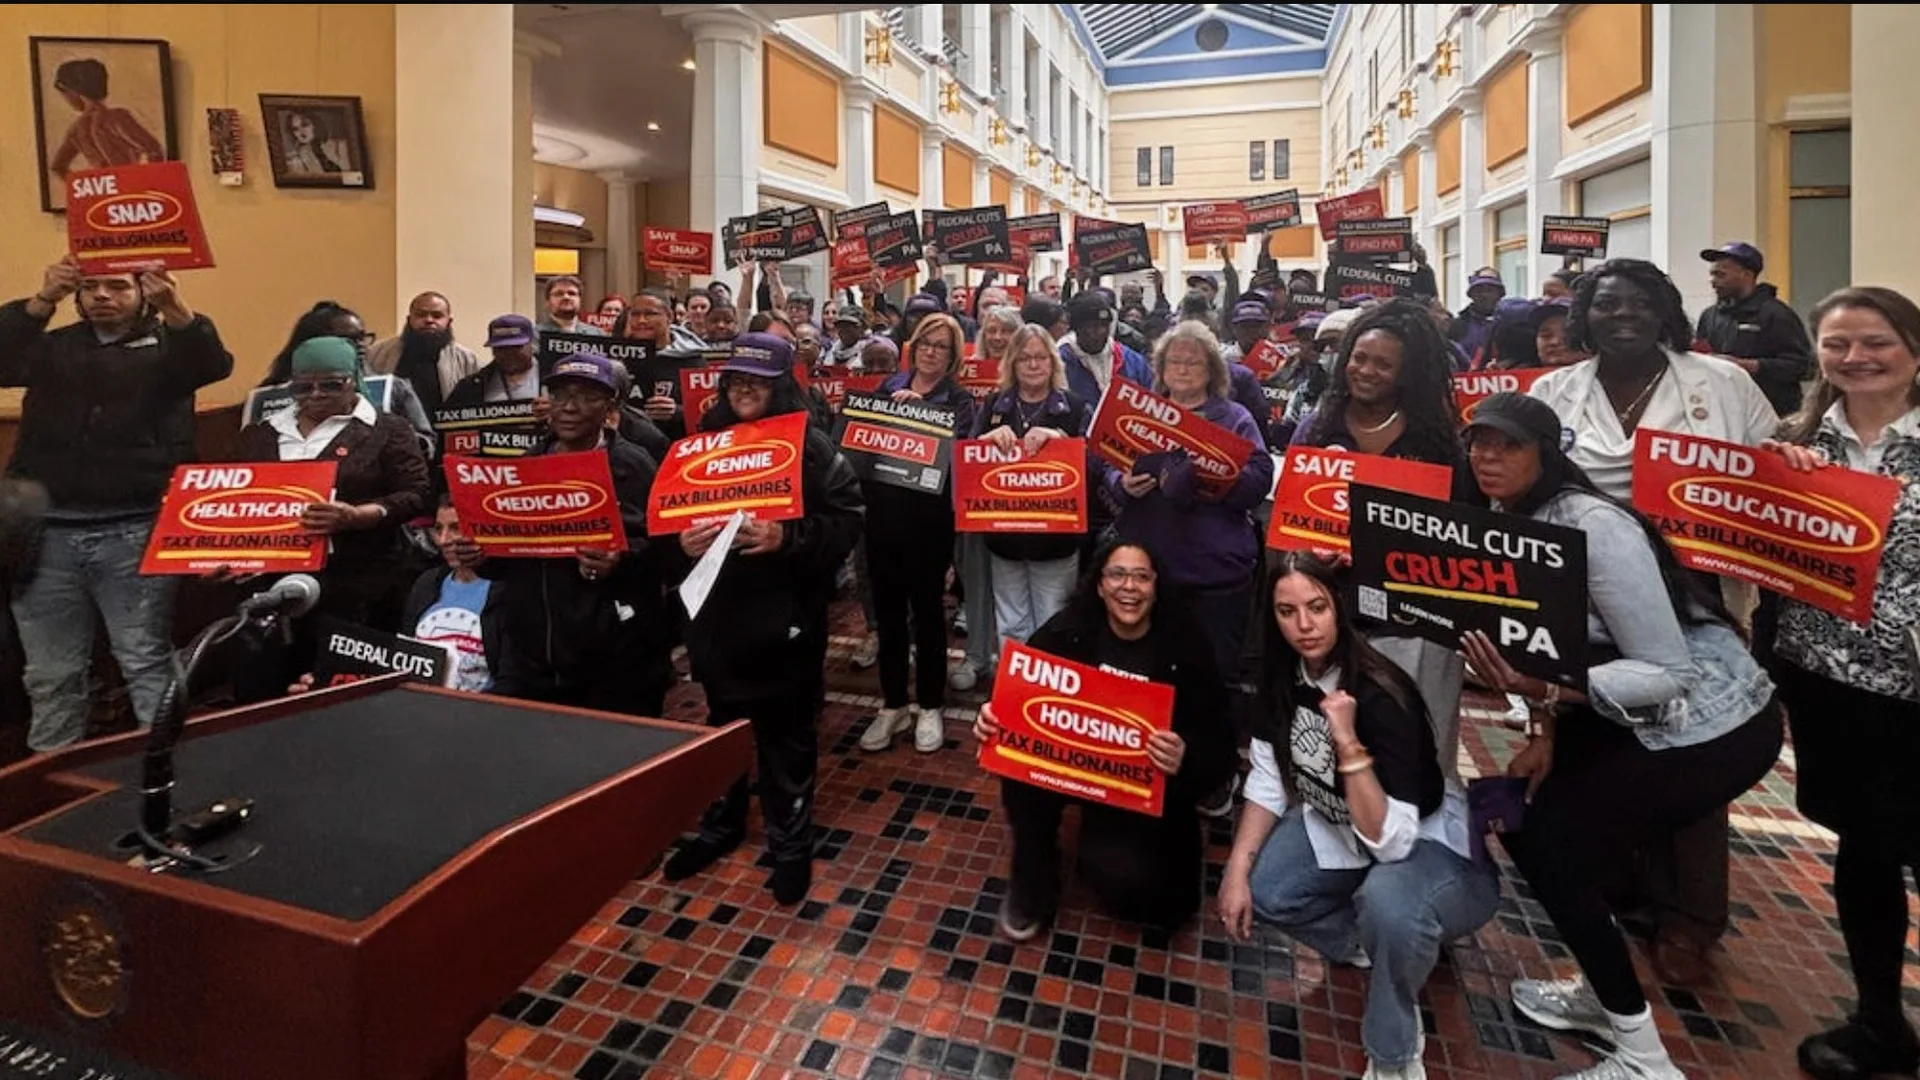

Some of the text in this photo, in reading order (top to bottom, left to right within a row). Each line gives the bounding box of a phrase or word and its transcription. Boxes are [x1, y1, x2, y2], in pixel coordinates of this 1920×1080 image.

[72, 175, 118, 198] SAVE
[107, 202, 164, 224] SNAP
[977, 210, 1000, 223] CUTS
[649, 230, 678, 241] SAVE
[985, 242, 1003, 255] PA
[1337, 266, 1412, 287] FEDERAL CUTS
[548, 339, 646, 359] FEDERAL CUTS
[1453, 375, 1519, 395] FUND
[435, 404, 532, 421] TAX BILLIONAIRE
[849, 396, 871, 410] TAX
[872, 400, 956, 427] BILLIONAIRES
[1116, 384, 1183, 426] FUND
[484, 432, 509, 446] TAX
[675, 430, 734, 458] SAVE
[853, 428, 926, 457] FUND PA
[706, 451, 773, 476] PENNIE
[964, 445, 1022, 463] FUND
[1650, 436, 1755, 478] FUND
[456, 464, 521, 485] SAVE
[1293, 453, 1355, 481] SAVE
[181, 468, 252, 490] FUND
[997, 473, 1064, 487] TRANSIT
[495, 492, 590, 511] MEDICAID
[660, 478, 792, 509] TAX BILLIONAIRES
[964, 499, 1077, 512] TAX BILLIONAIRES
[1684, 484, 1857, 546] EDUCATION
[469, 516, 611, 536] TAX BILLIONAIRES
[1281, 512, 1310, 529] TAX
[163, 534, 313, 549] TAX BILLIONAIRES
[1367, 502, 1478, 549] FEDERAL
[1484, 530, 1564, 568] CUTS
[1694, 523, 1857, 588] BILLIONAIRES
[1385, 551, 1519, 596] CRUSH
[1501, 616, 1561, 660] PA
[329, 634, 435, 678] FEDERAL CUTS
[1009, 651, 1081, 695] FUND
[1039, 703, 1141, 748] HOUSING
[999, 728, 1153, 785] TAX BILLIONAIRES
